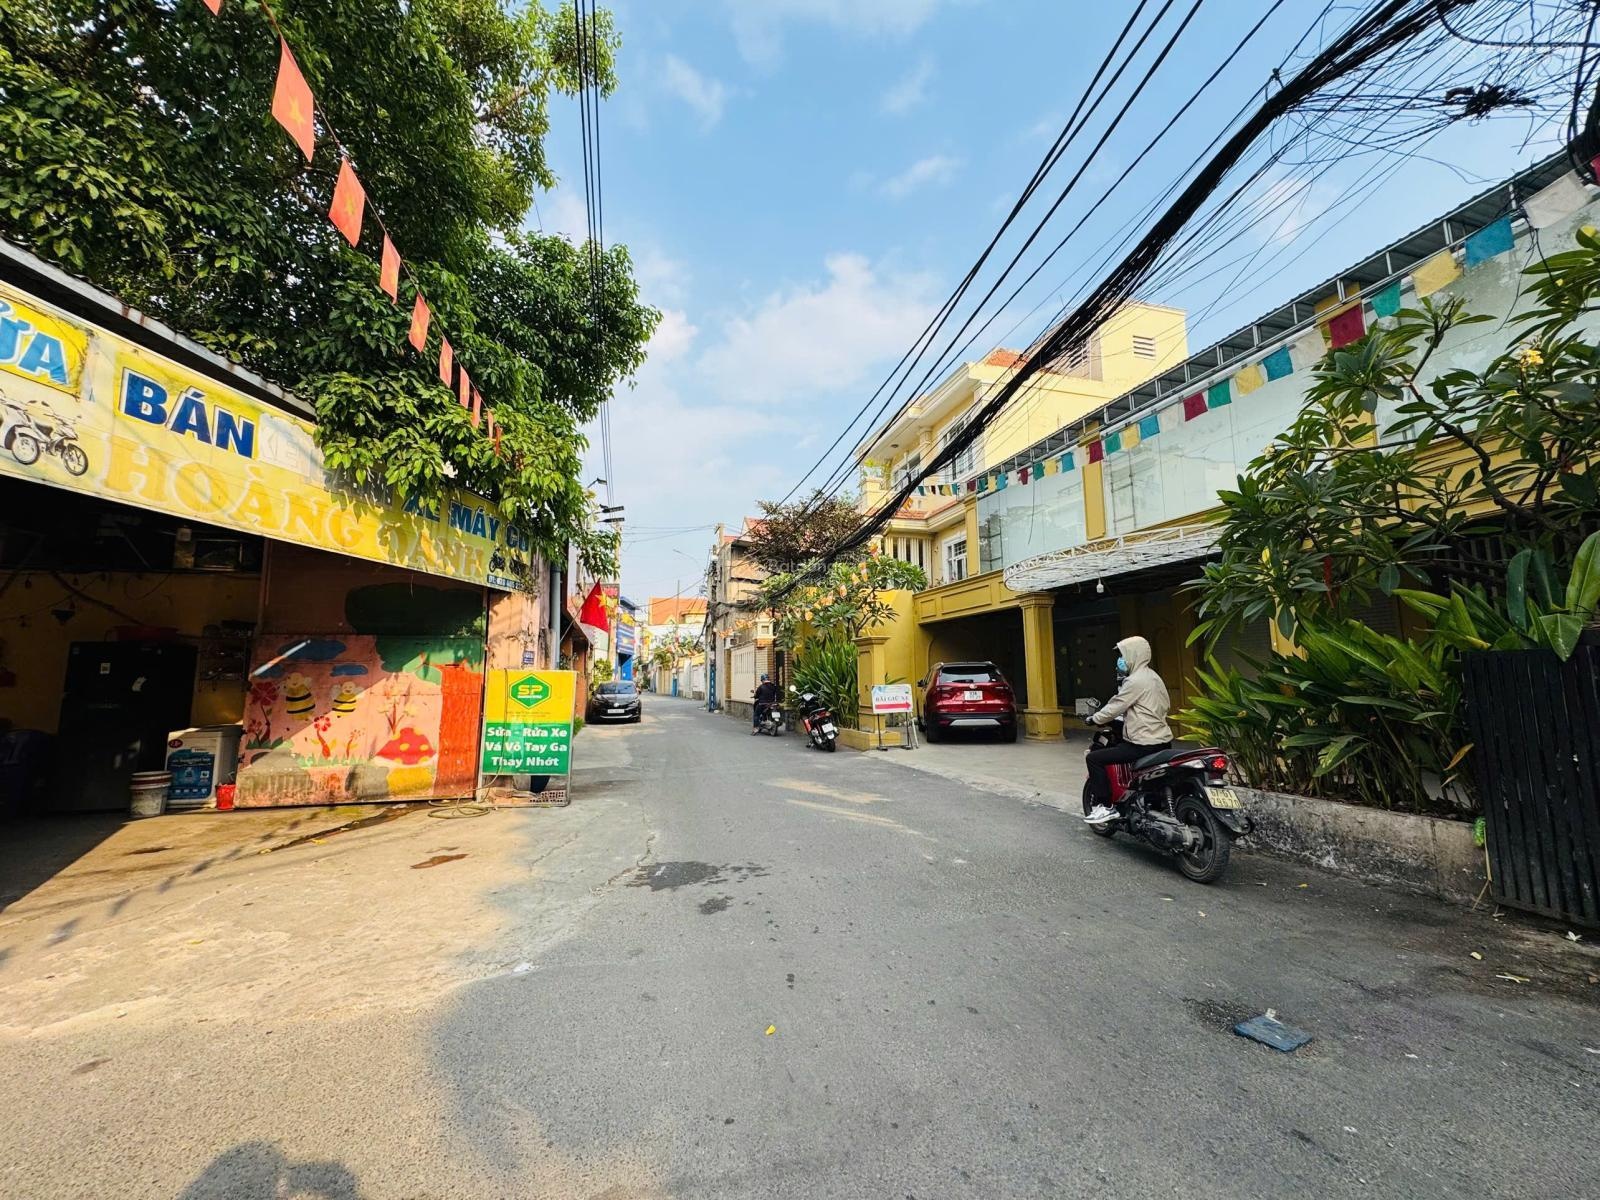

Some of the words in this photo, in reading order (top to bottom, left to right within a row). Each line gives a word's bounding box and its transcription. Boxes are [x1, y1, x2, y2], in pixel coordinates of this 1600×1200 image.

[120, 368, 256, 461] BÁN
[449, 499, 500, 541] MÁY
[101, 434, 364, 549] HOÀNG
[517, 684, 543, 696] SP
[551, 727, 568, 738] Xe
[485, 741, 502, 752] Vá
[524, 742, 548, 754] Tay
[549, 742, 568, 752] Ga
[491, 756, 523, 768] Thay
[526, 756, 560, 767] Nhớt
